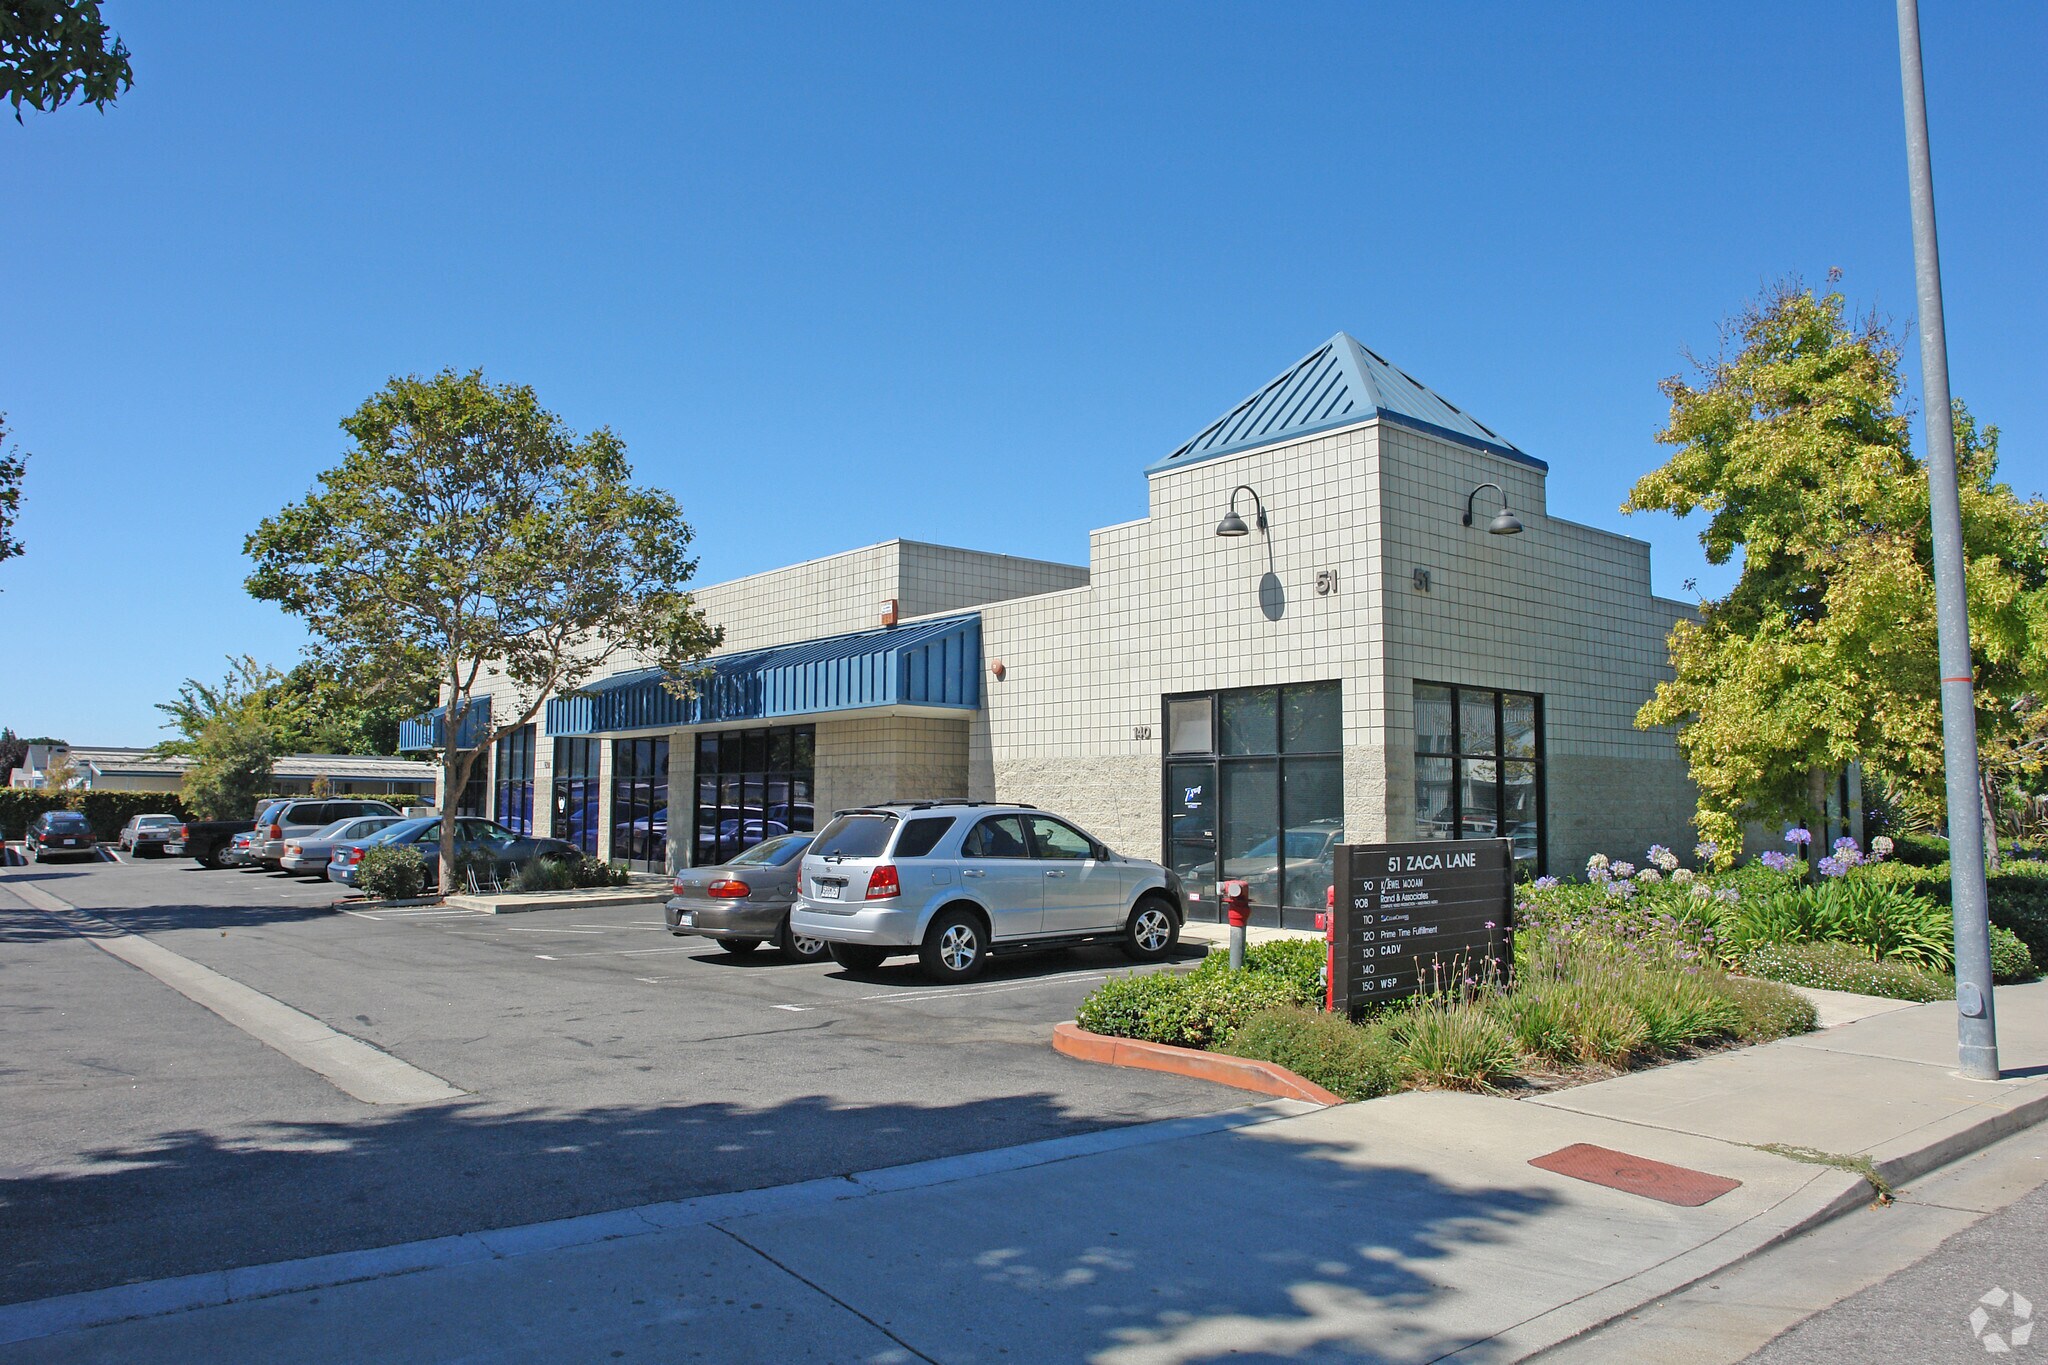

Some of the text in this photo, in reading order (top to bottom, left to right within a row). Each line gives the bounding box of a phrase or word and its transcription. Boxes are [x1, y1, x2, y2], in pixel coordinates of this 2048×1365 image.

[1316, 569, 1338, 596] 51
[1413, 568, 1431, 593] 51
[1388, 852, 1476, 872] 51 ZACA LANE
[1363, 880, 1374, 891] 90
[1380, 893, 1396, 904] Rand
[1401, 891, 1430, 902] Associates
[1363, 914, 1374, 925] 110
[1362, 926, 1438, 942] 120 Prime Time Fulfillment
[1362, 943, 1402, 959] 130 CADV
[1362, 963, 1375, 975] 140
[1362, 977, 1397, 992] 150 WSP
